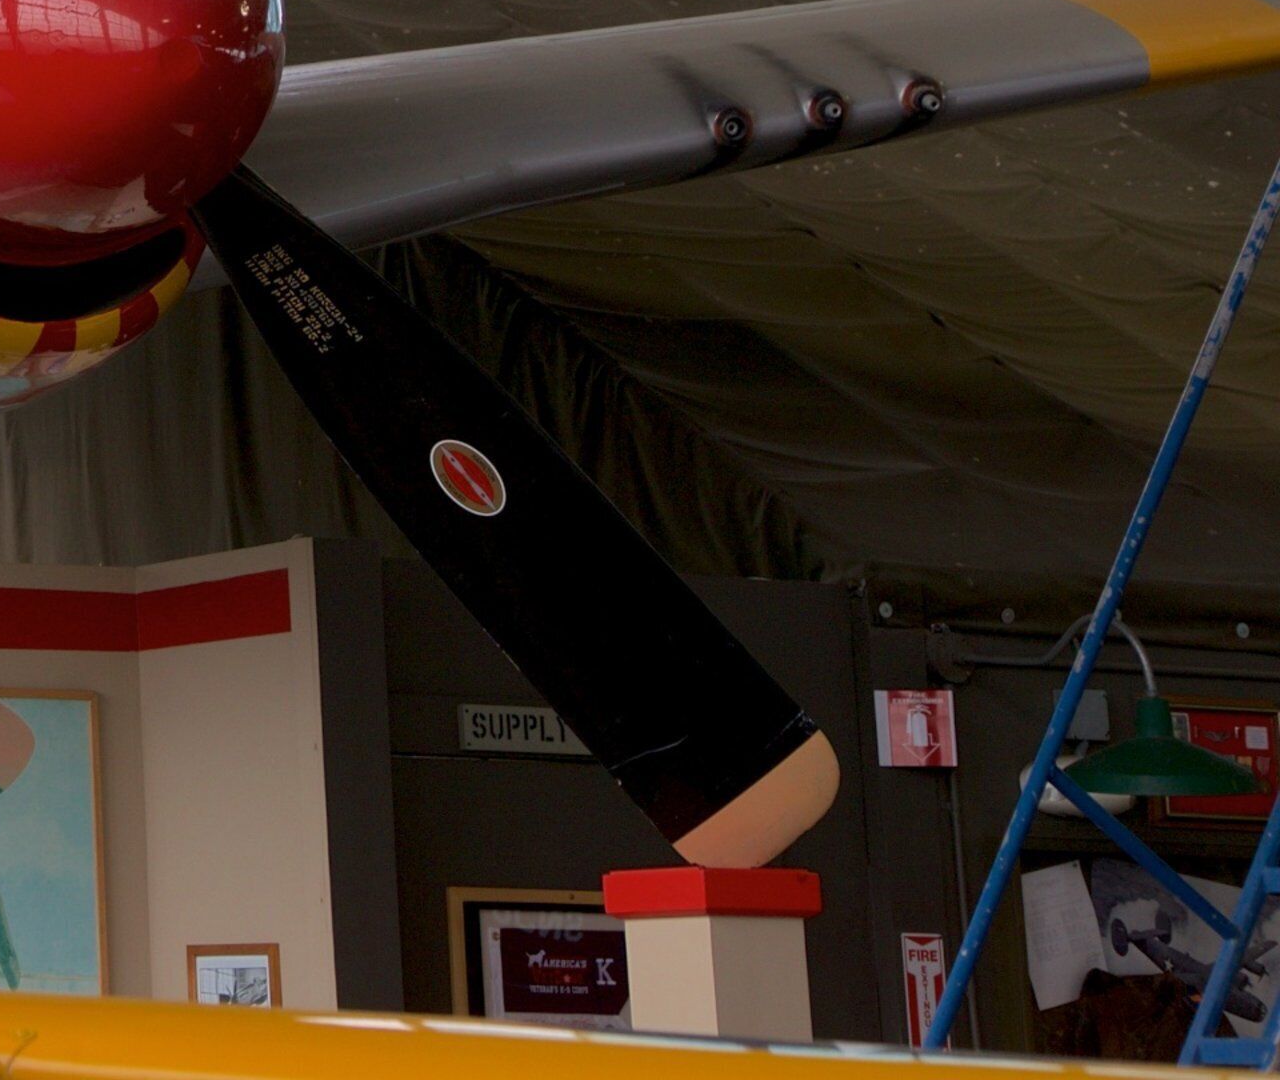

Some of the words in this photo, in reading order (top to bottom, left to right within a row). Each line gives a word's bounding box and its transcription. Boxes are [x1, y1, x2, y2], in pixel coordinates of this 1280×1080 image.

[263, 250, 283, 271] SER
[244, 259, 270, 286] HIGH
[271, 289, 302, 323] PITCH
[302, 325, 328, 354] 65.2
[273, 277, 305, 311] PITCH
[305, 314, 331, 341] 23.2
[472, 711, 566, 743] SUPPLY
[908, 949, 938, 962] FIRE
[543, 959, 587, 968] AMERICA'S
[595, 958, 617, 986] K
[920, 965, 932, 1028] EXTINGU
